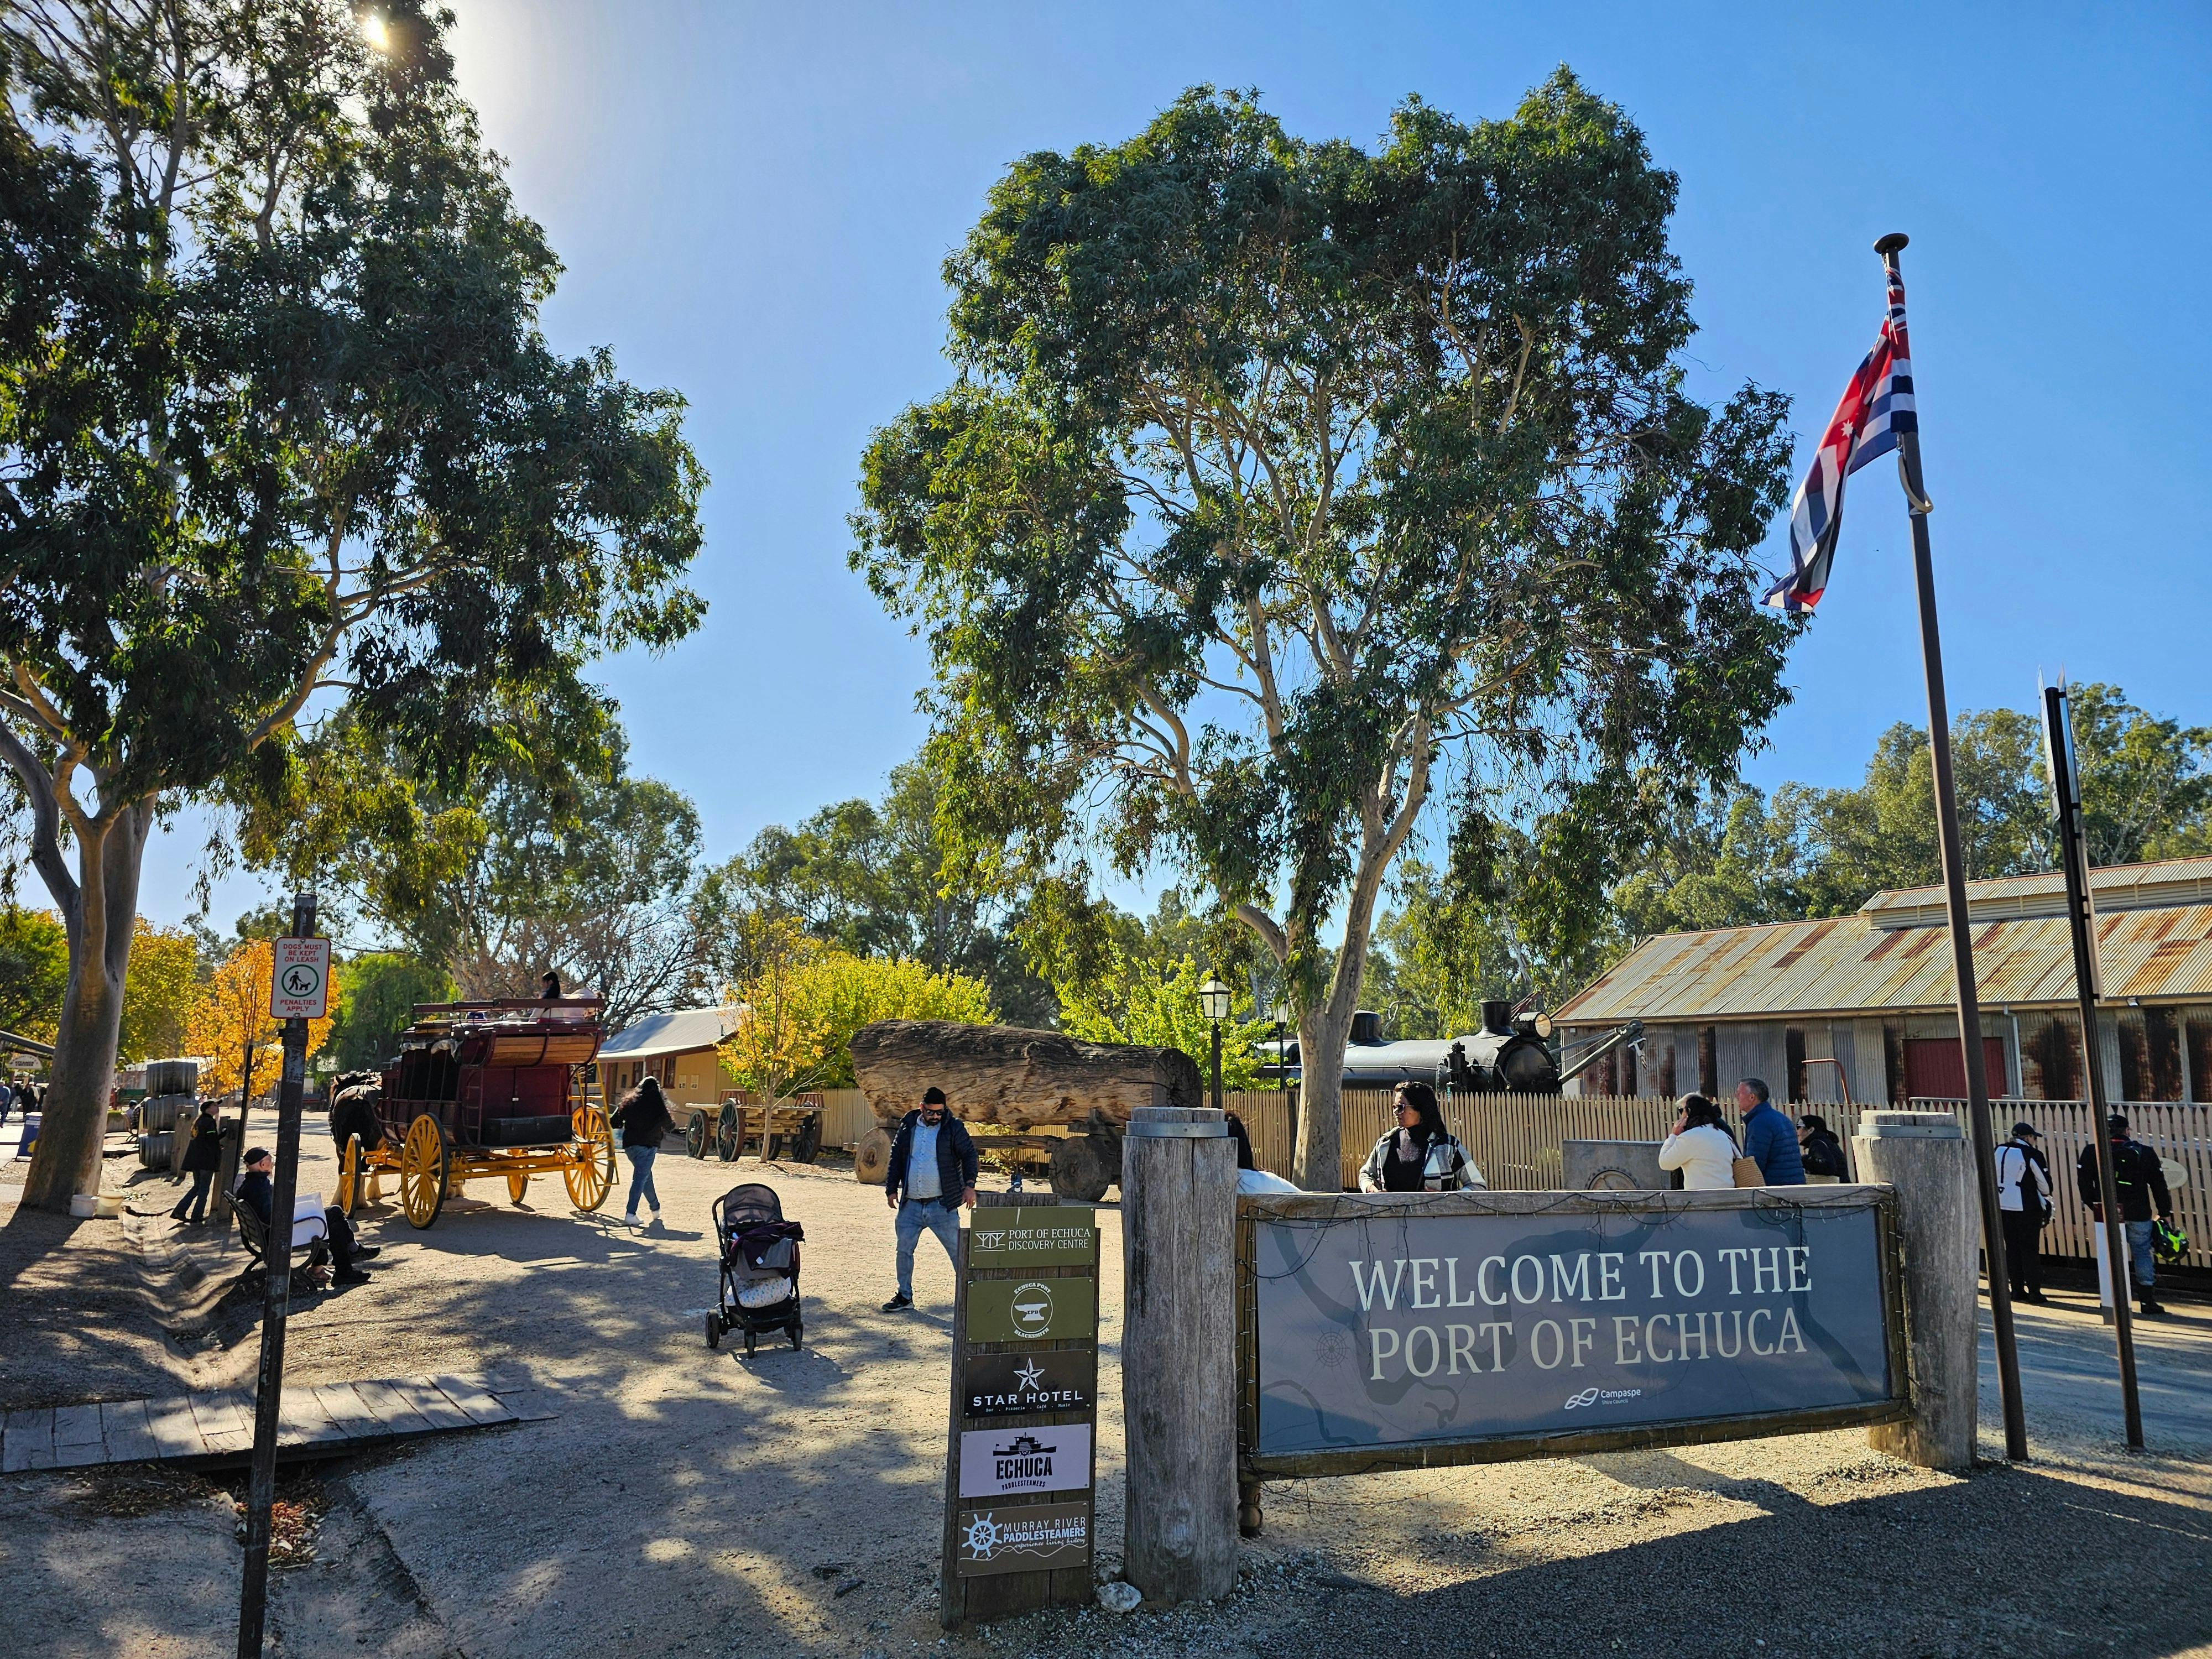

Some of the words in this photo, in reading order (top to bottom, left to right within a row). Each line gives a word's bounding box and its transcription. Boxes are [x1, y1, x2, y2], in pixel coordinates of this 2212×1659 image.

[1009, 1230, 1034, 1239] PORT
[1036, 1229, 1048, 1238] OF
[1051, 1228, 1091, 1238] ECHUCA
[1009, 1240, 1055, 1250] DISCOVERY
[1057, 1239, 1088, 1249] CENTRE
[1348, 1252, 1626, 1311] WELCOME
[1640, 1249, 1705, 1298] TO
[1718, 1246, 1812, 1295] THE
[1014, 1282, 1036, 1295] ECHUCA
[1036, 1282, 1051, 1293] PORT
[1014, 1327, 1050, 1339] BLACKSMITH
[1369, 1321, 1513, 1381] PORT
[1530, 1317, 1597, 1370] OF
[1614, 1306, 1808, 1366] ECHUCA
[973, 1394, 1018, 1406] STAR
[1026, 1390, 1083, 1404] HOTEL
[1600, 1388, 1641, 1399] Campaspe
[996, 1457, 1053, 1480] ECHUCA
[1001, 1480, 1046, 1491] PADDLESTEAMERS
[1004, 1520, 1050, 1533] MURRAY
[1055, 1516, 1086, 1528] RIVER
[1003, 1526, 1086, 1543] PADDLESTEAMERS
[1014, 1541, 1044, 1550] experience
